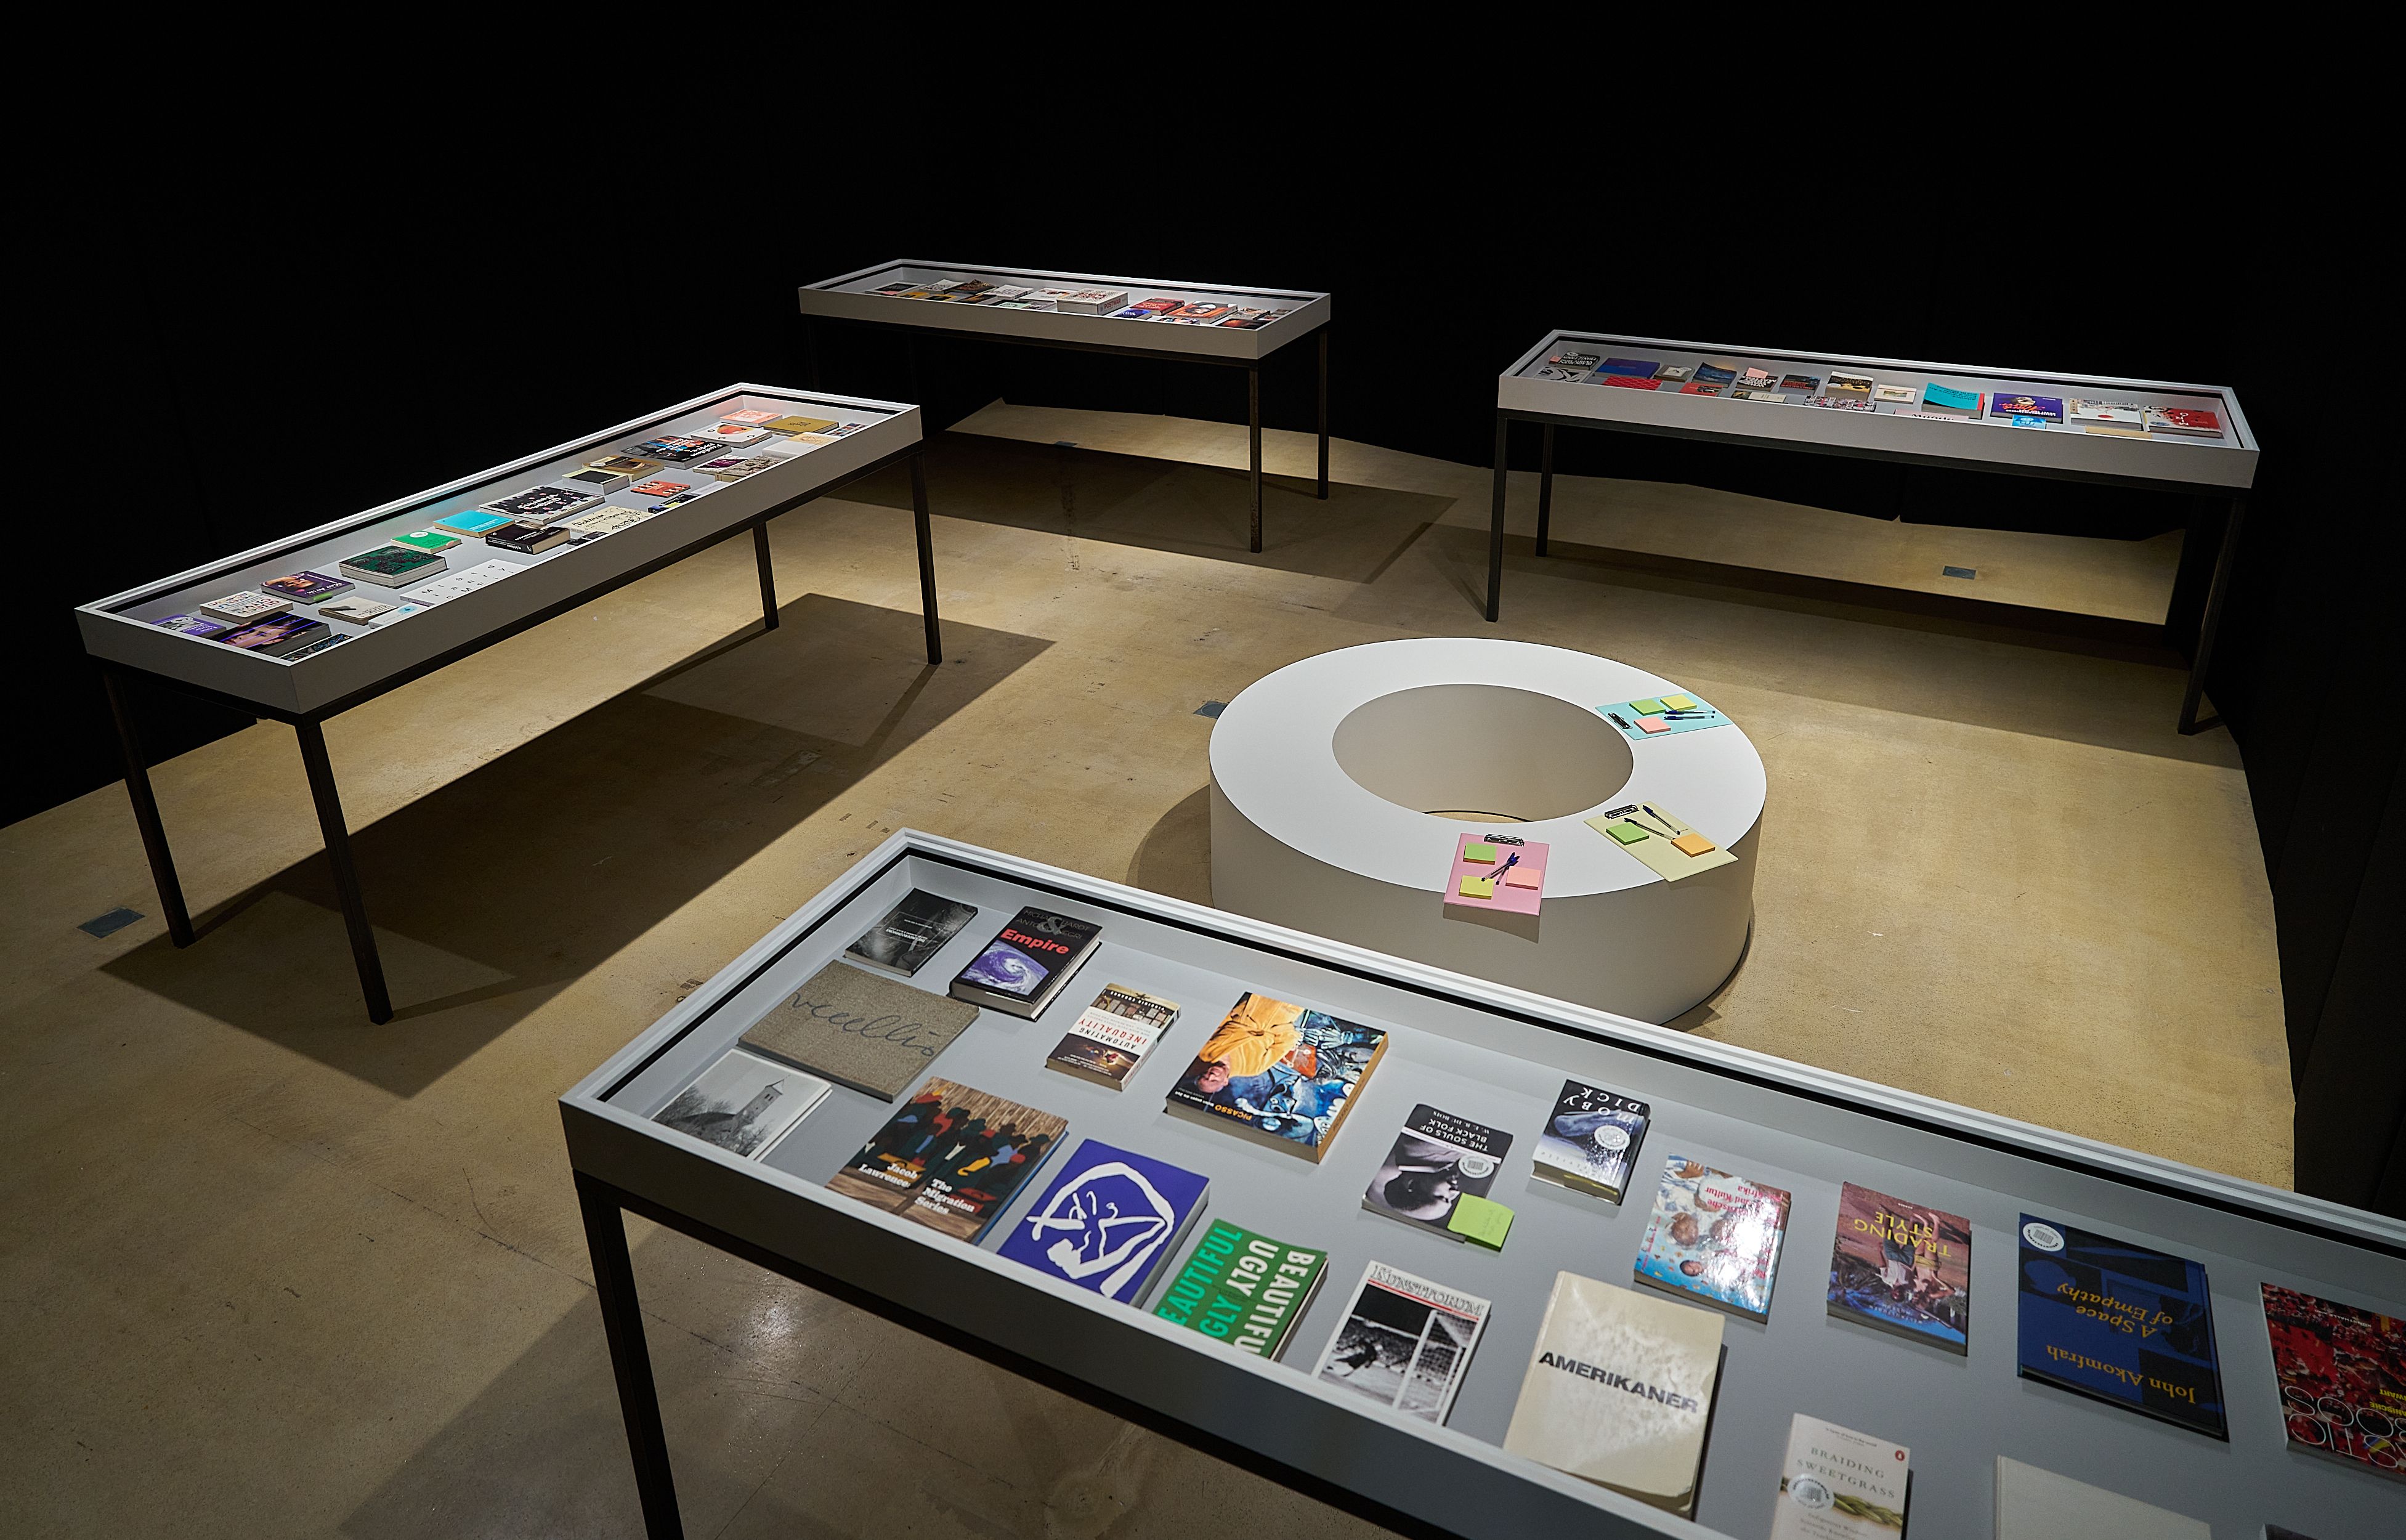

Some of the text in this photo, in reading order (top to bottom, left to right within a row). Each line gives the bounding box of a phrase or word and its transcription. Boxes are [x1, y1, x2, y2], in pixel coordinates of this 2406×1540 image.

[245, 598, 271, 609] CITY
[1036, 916, 1067, 935] &
[1000, 928, 1070, 954] Empire
[1079, 1018, 1148, 1045] INEQUALITY
[1079, 1027, 1136, 1050] AUTOMATING
[1214, 1104, 1253, 1121] PICASSO
[1581, 1087, 1641, 1112] DICK
[1419, 1124, 1489, 1153] THE SOULS OF
[1428, 1118, 1488, 1144] BLACK FOLK
[886, 1163, 918, 1180] Jacob
[931, 1178, 953, 1193] The
[1705, 1186, 1733, 1202] Kultur
[914, 1196, 950, 1215] Series
[922, 1187, 976, 1214] Migration
[1853, 1218, 1951, 1258] TRADING
[1874, 1211, 1934, 1238] STYLE
[1157, 1226, 1243, 1326] EAUTIFUL
[1226, 1239, 1279, 1297] UGLY
[1199, 1294, 1242, 1337] GLY
[1234, 1250, 1316, 1354] BEAUTIFU
[2057, 1283, 2174, 1326] of Empathy
[2075, 1305, 2158, 1338] A Space
[1538, 1351, 1699, 1414] AMERIKANER
[2046, 1344, 2197, 1404] John Akomfrah
[2370, 1401, 2406, 1416] ANISCHE
[1810, 1447, 1885, 1479] BRAIDING
[1797, 1459, 1895, 1499] SWEETGRASS
